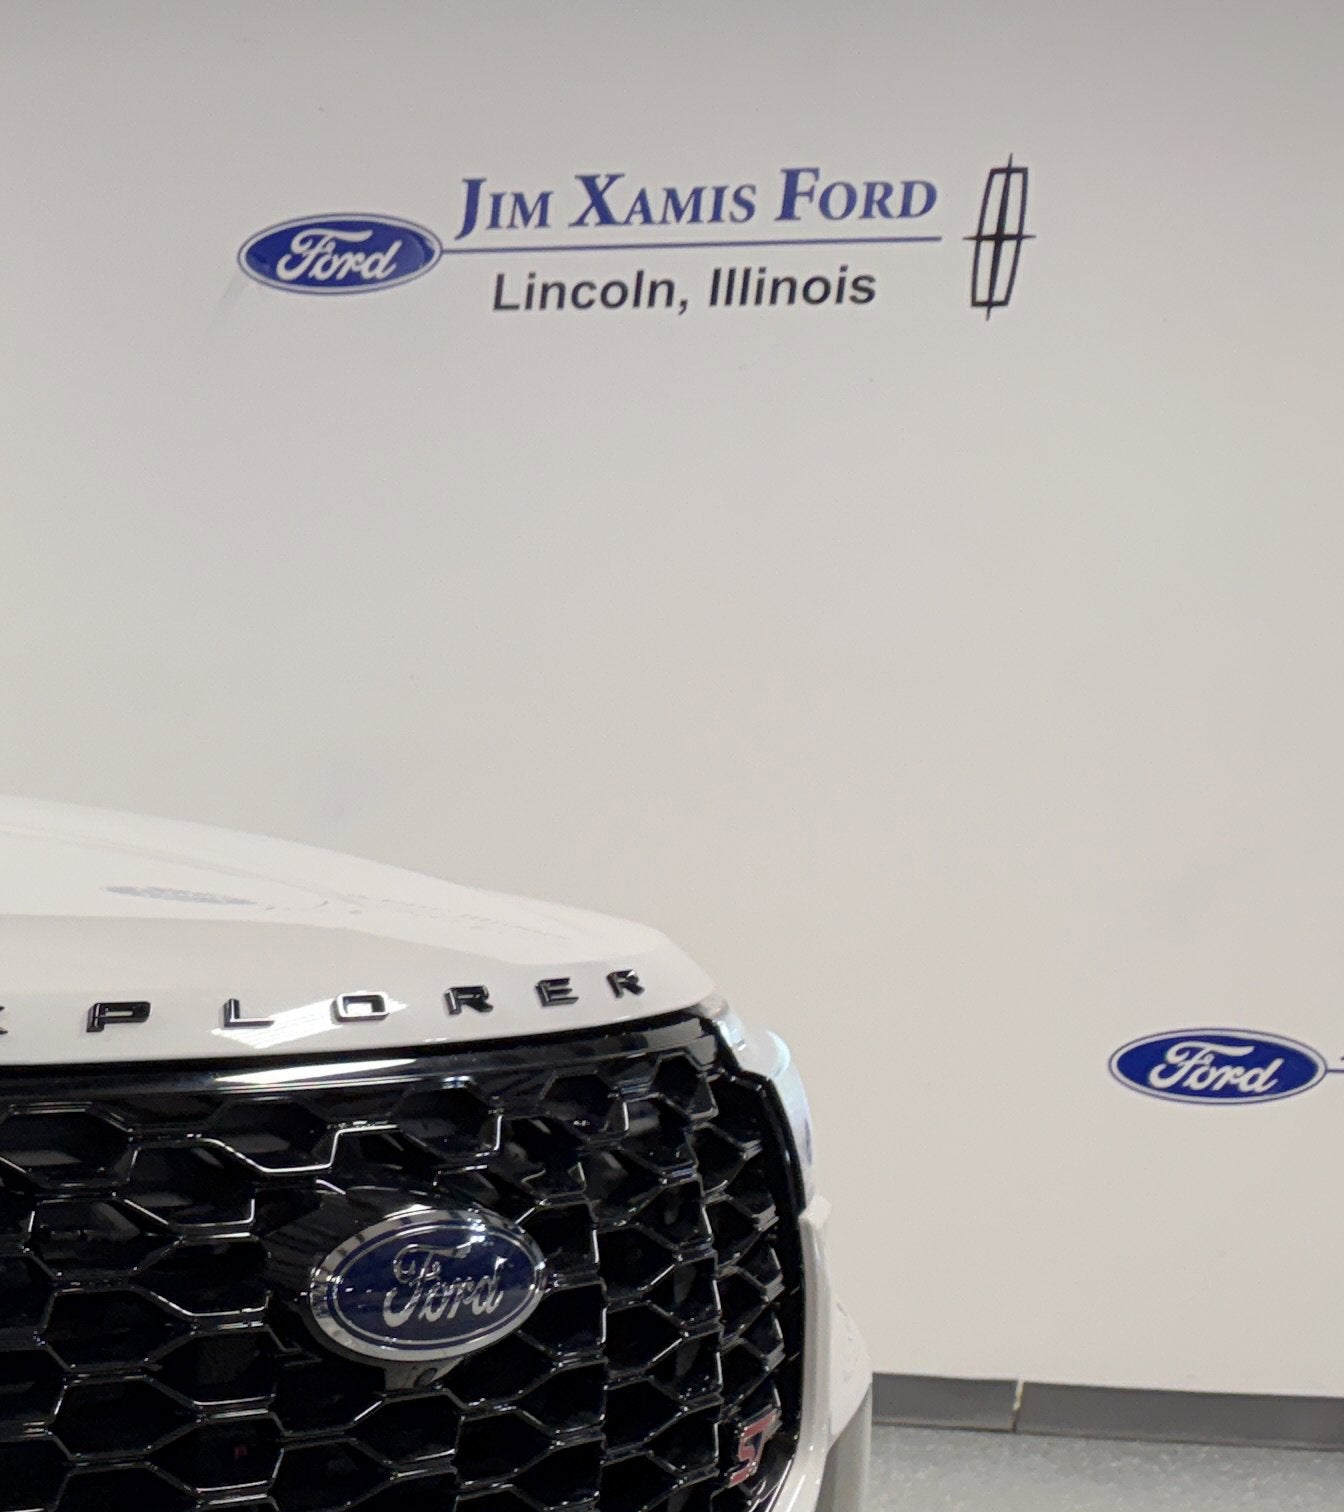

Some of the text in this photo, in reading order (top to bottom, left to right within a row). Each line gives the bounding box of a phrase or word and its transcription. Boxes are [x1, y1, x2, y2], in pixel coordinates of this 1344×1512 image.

[454, 167, 937, 241] JIM XAMIS FORD
[276, 228, 402, 281] Ford
[493, 265, 876, 316] Lincoln, Illinois
[1148, 1040, 1284, 1094] Ford
[382, 1242, 508, 1328] Ford
